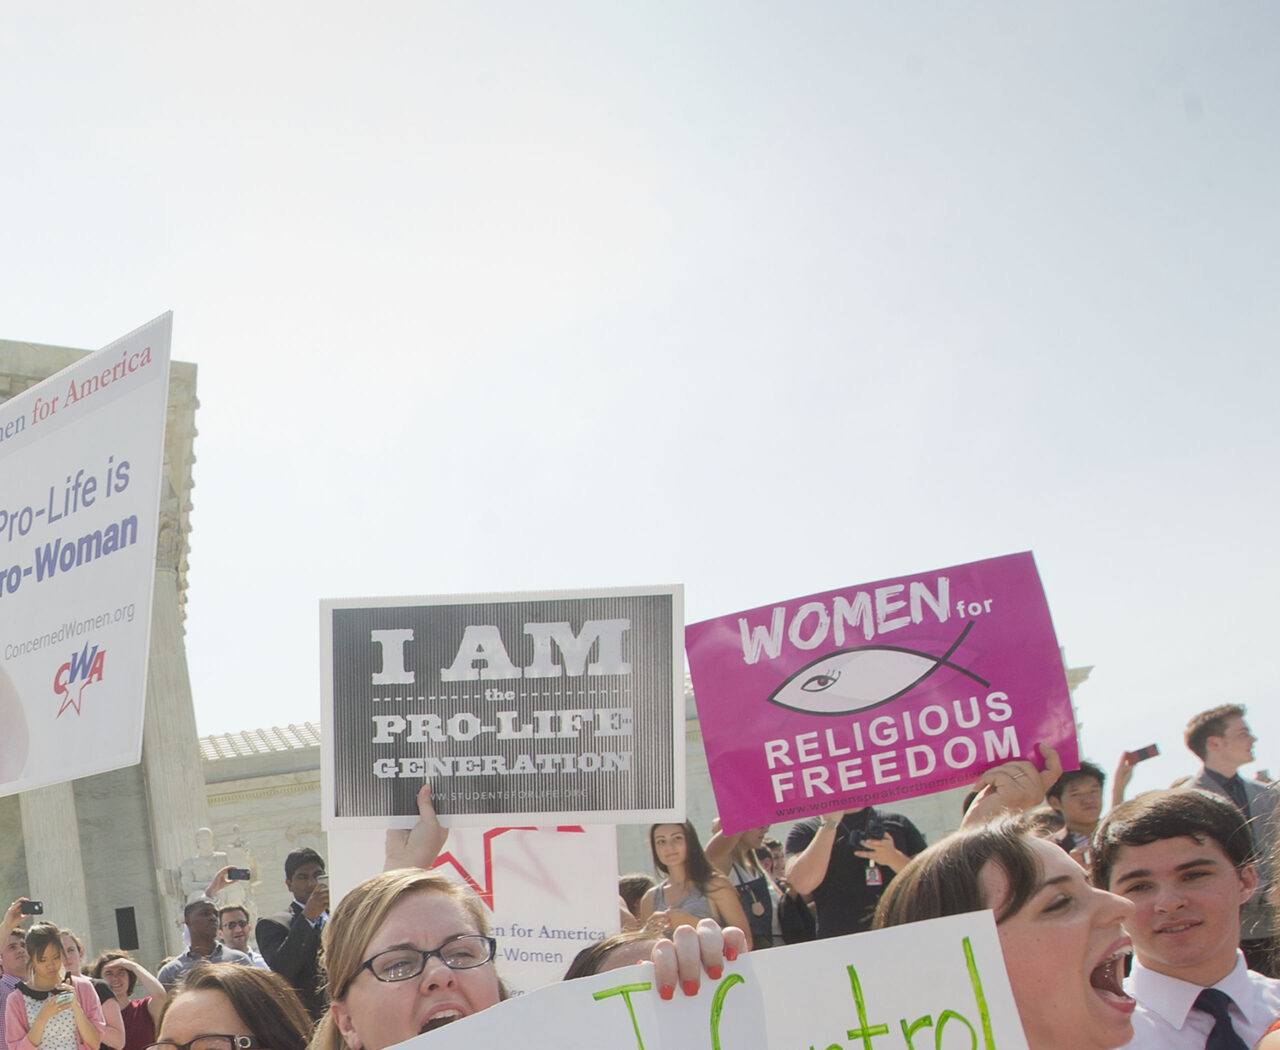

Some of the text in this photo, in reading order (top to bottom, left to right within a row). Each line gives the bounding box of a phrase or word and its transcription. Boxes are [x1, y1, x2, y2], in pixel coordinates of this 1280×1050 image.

[31, 397, 59, 425] for
[64, 345, 152, 409] America
[106, 455, 131, 498] is
[4, 603, 136, 661] ConcernedWomen.org
[738, 577, 993, 665] WOMEN for
[53, 641, 106, 695] CWA
[371, 618, 632, 685] I AM
[485, 688, 516, 701] the
[372, 708, 633, 743] PRO-LIFE
[764, 691, 1013, 769] RELIGIOUS
[372, 751, 633, 779] GENERATION
[771, 725, 1021, 804] FREEDOM
[497, 948, 563, 964] -Women
[511, 923, 533, 938] for
[538, 925, 606, 941] America
